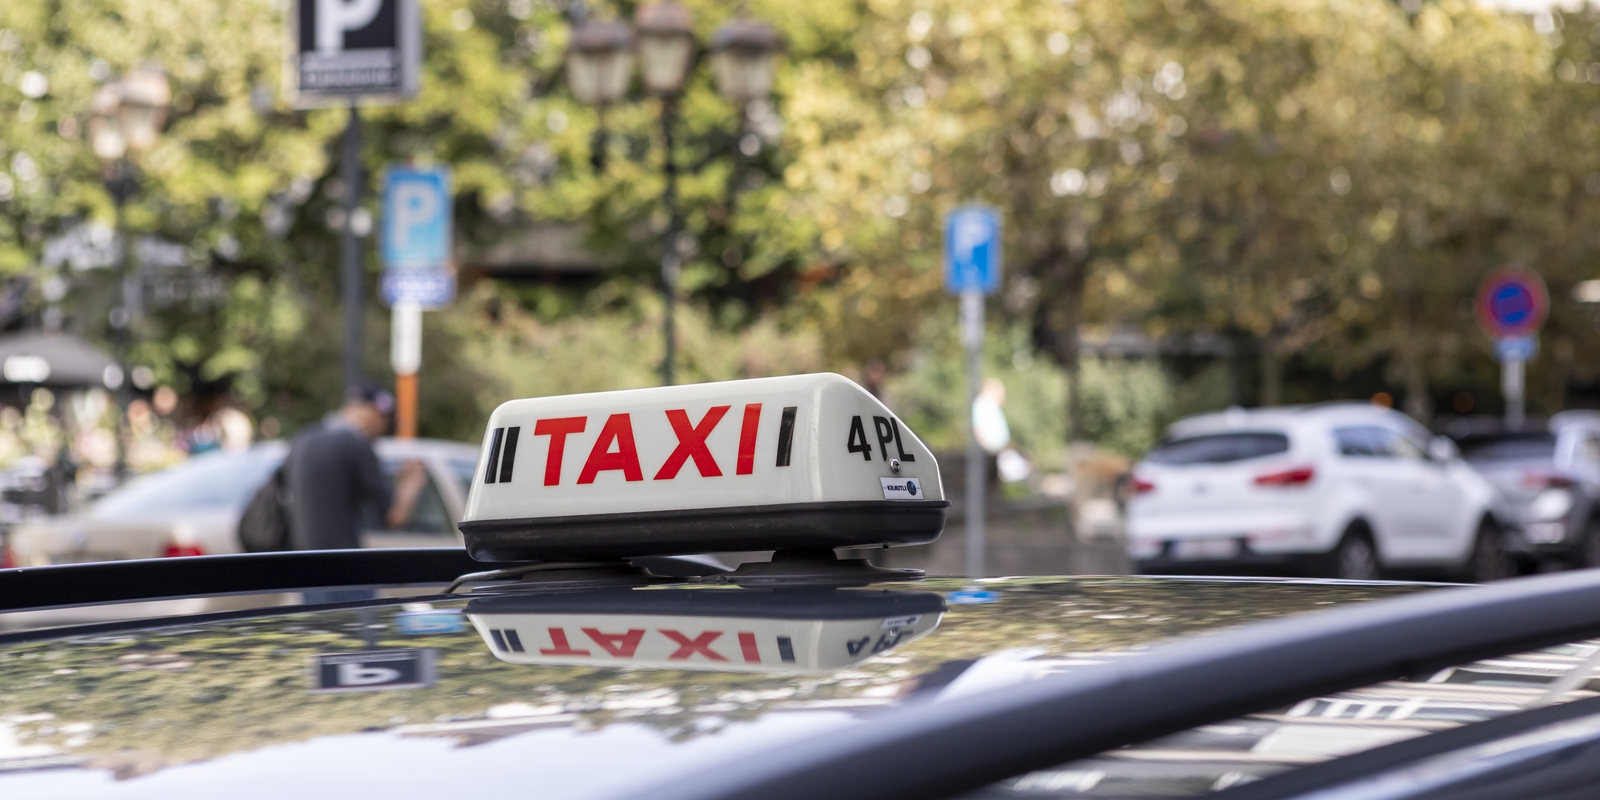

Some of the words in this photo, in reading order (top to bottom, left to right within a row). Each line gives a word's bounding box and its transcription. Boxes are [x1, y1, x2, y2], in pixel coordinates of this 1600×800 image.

[315, 0, 384, 57] P
[395, 182, 439, 249] P
[534, 403, 762, 487] TAXI
[847, 415, 872, 461] 4
[873, 415, 916, 462] PL
